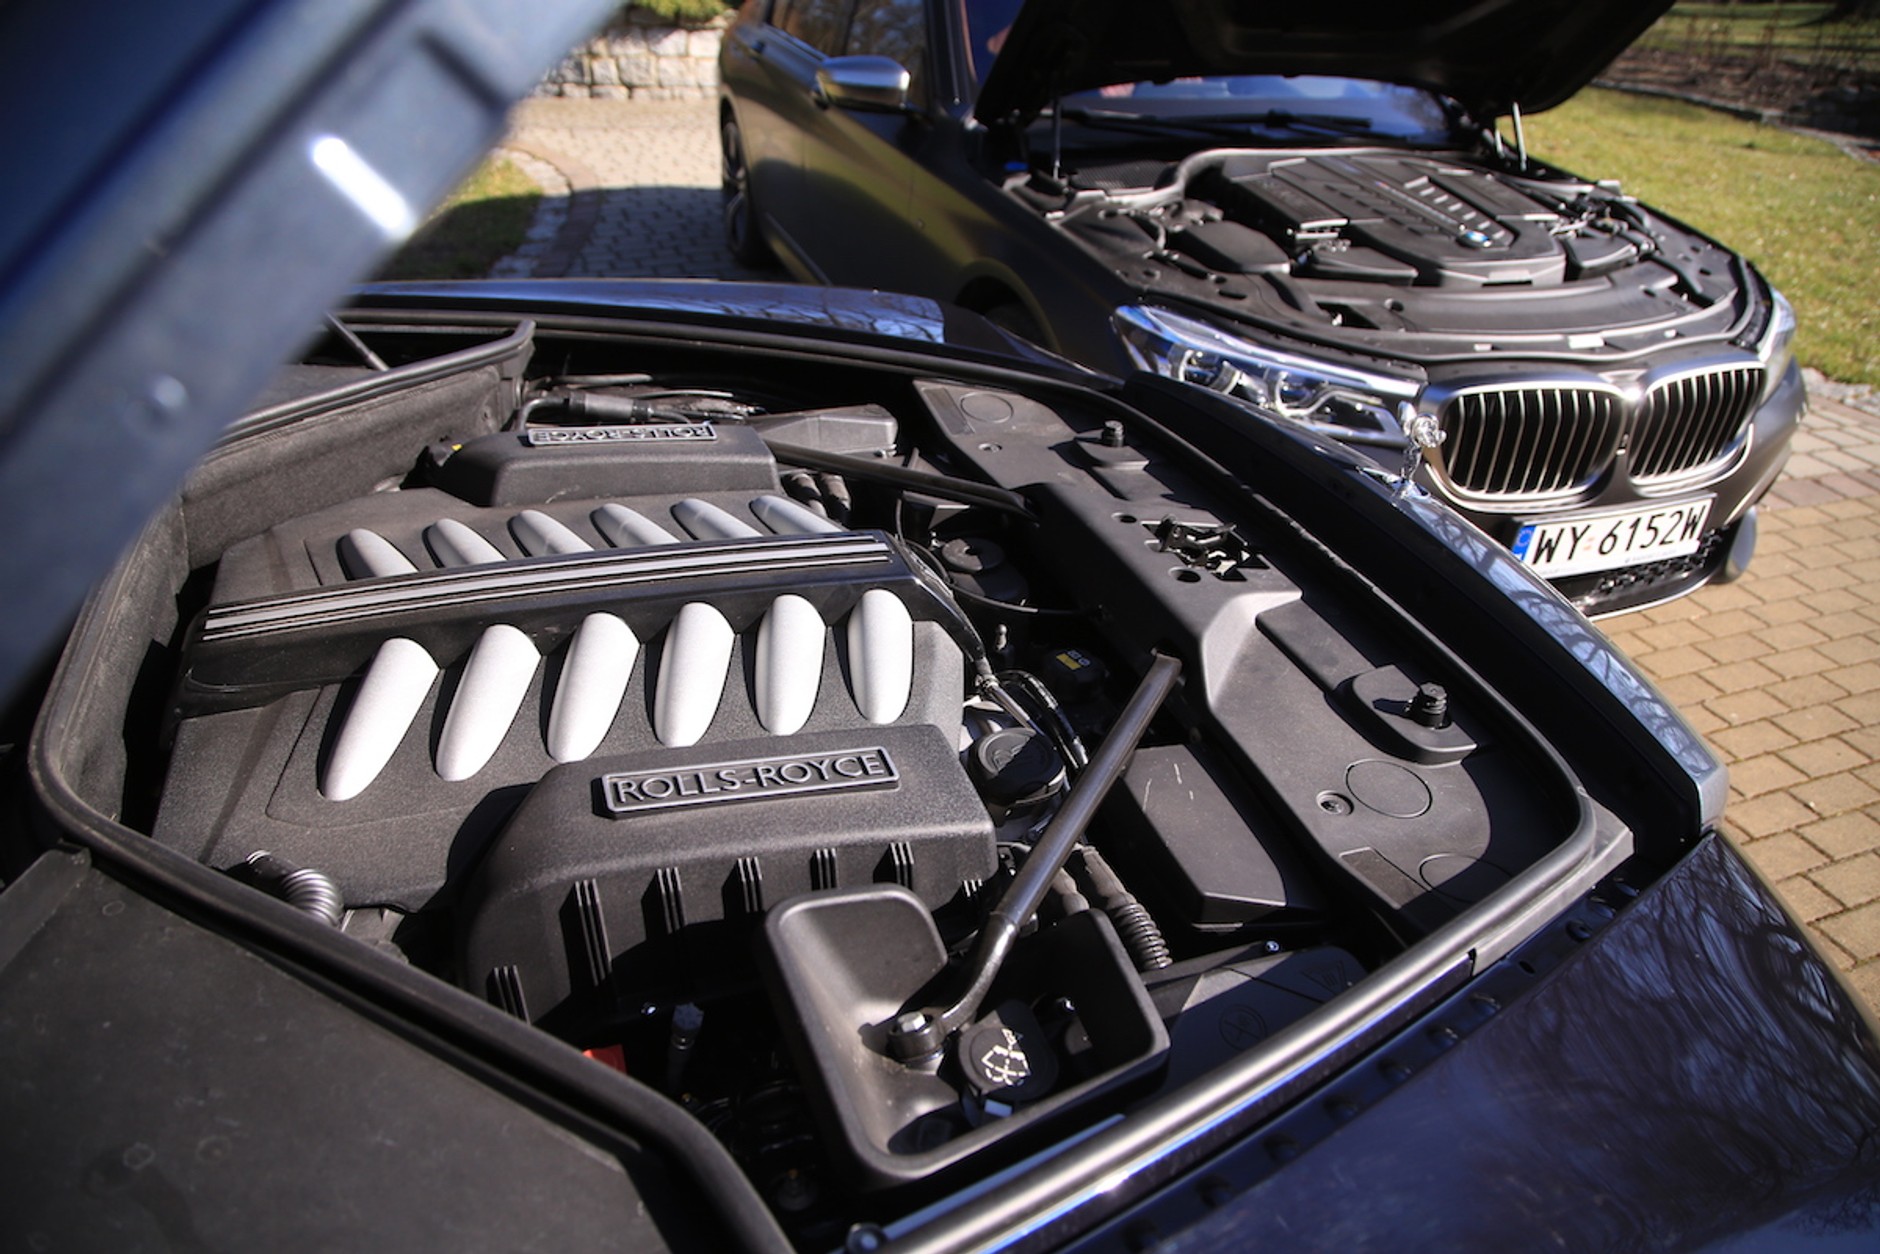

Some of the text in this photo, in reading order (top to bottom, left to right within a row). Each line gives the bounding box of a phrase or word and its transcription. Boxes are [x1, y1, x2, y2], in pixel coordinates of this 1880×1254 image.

[1532, 505, 1706, 566] WY 6152W
[616, 753, 884, 802] ROLLS-ROYCE
